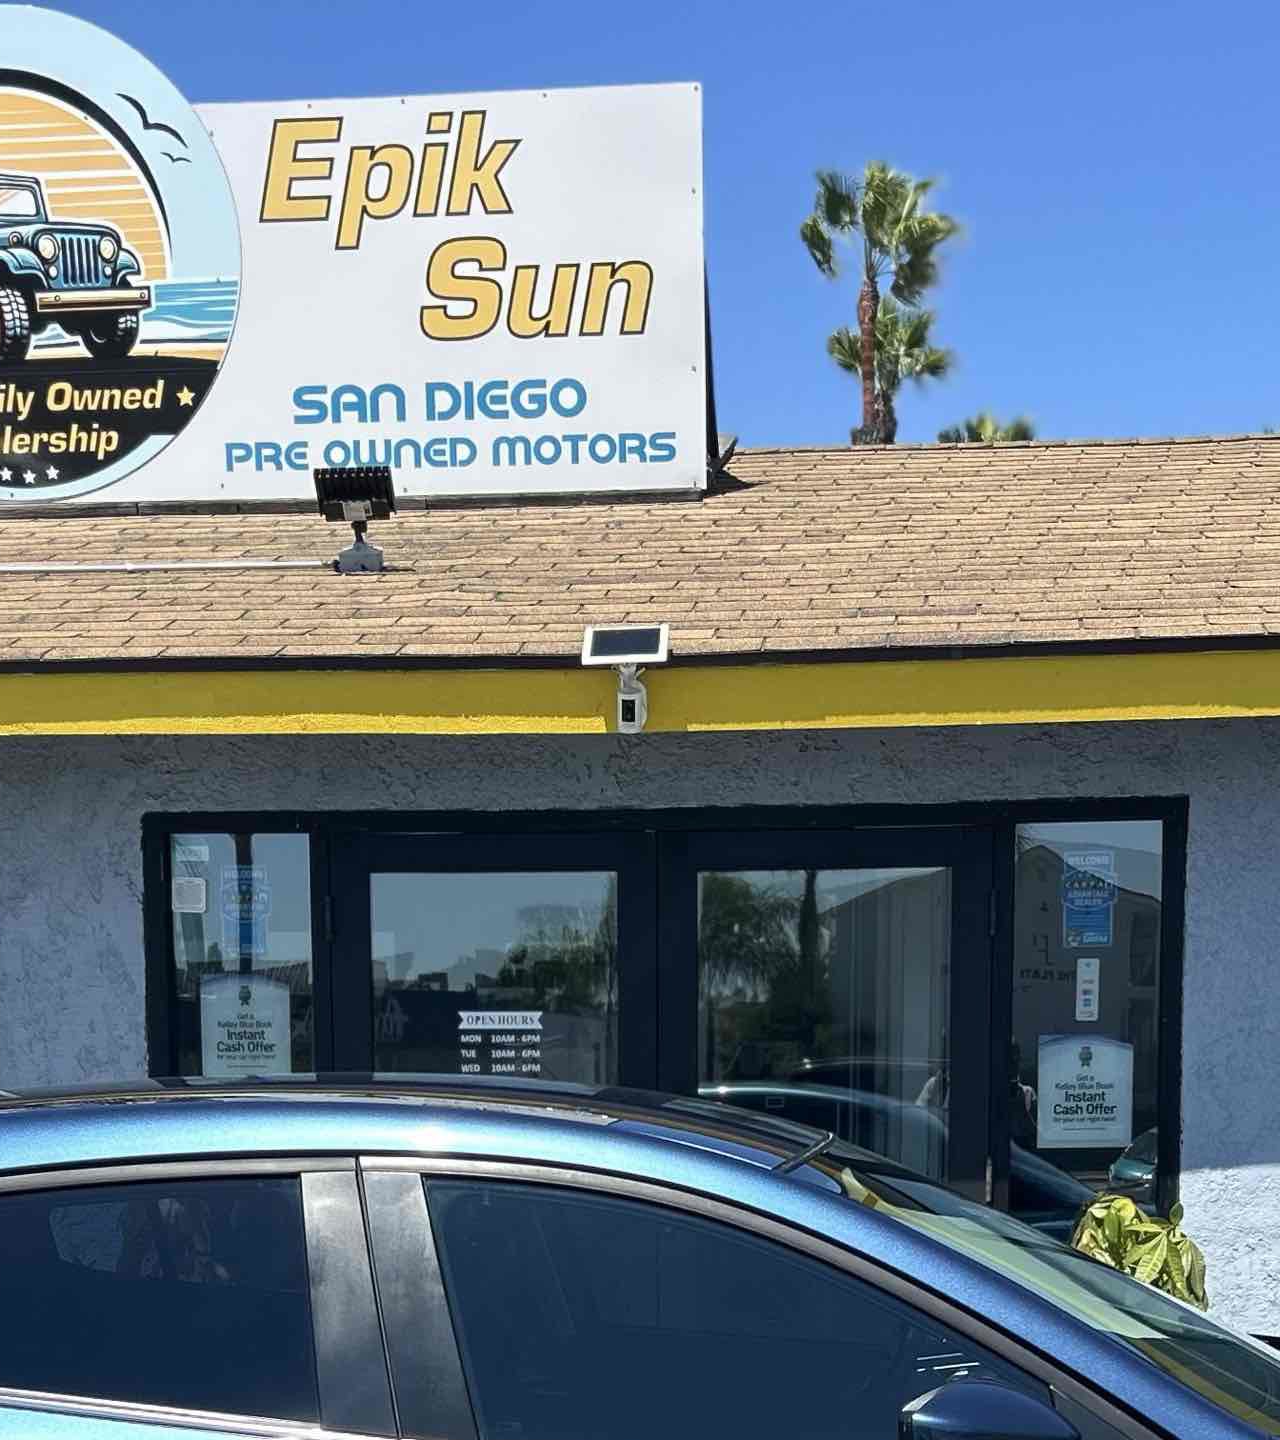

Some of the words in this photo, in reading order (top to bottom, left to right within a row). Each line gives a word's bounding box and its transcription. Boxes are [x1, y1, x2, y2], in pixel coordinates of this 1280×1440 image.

[259, 110, 523, 250] Epik
[419, 235, 654, 342] Sun
[46, 380, 164, 412] Owned
[293, 383, 406, 424] SAN
[425, 378, 587, 422] DIEGO
[225, 441, 309, 472] PRE
[323, 437, 477, 470] OWNED
[492, 432, 677, 466] MOTORS
[466, 1015, 496, 1025] OPEN
[498, 1015, 536, 1025] HOURS
[226, 1029, 266, 1041] Instant
[460, 1034, 482, 1043] MON
[491, 1034, 516, 1043] 10AM
[521, 1034, 541, 1043] 6PM
[216, 1041, 245, 1053] Cash
[247, 1041, 276, 1053] Offer
[460, 1049, 477, 1058] TUE
[491, 1049, 516, 1058] 10AM
[521, 1049, 541, 1058] 6PM
[460, 1064, 481, 1073] WED
[491, 1064, 516, 1073] 10AM
[521, 1064, 541, 1073] 6PM
[1064, 1091, 1106, 1102] Instant
[1053, 1103, 1083, 1115] Cash
[1086, 1103, 1117, 1115] Offer
